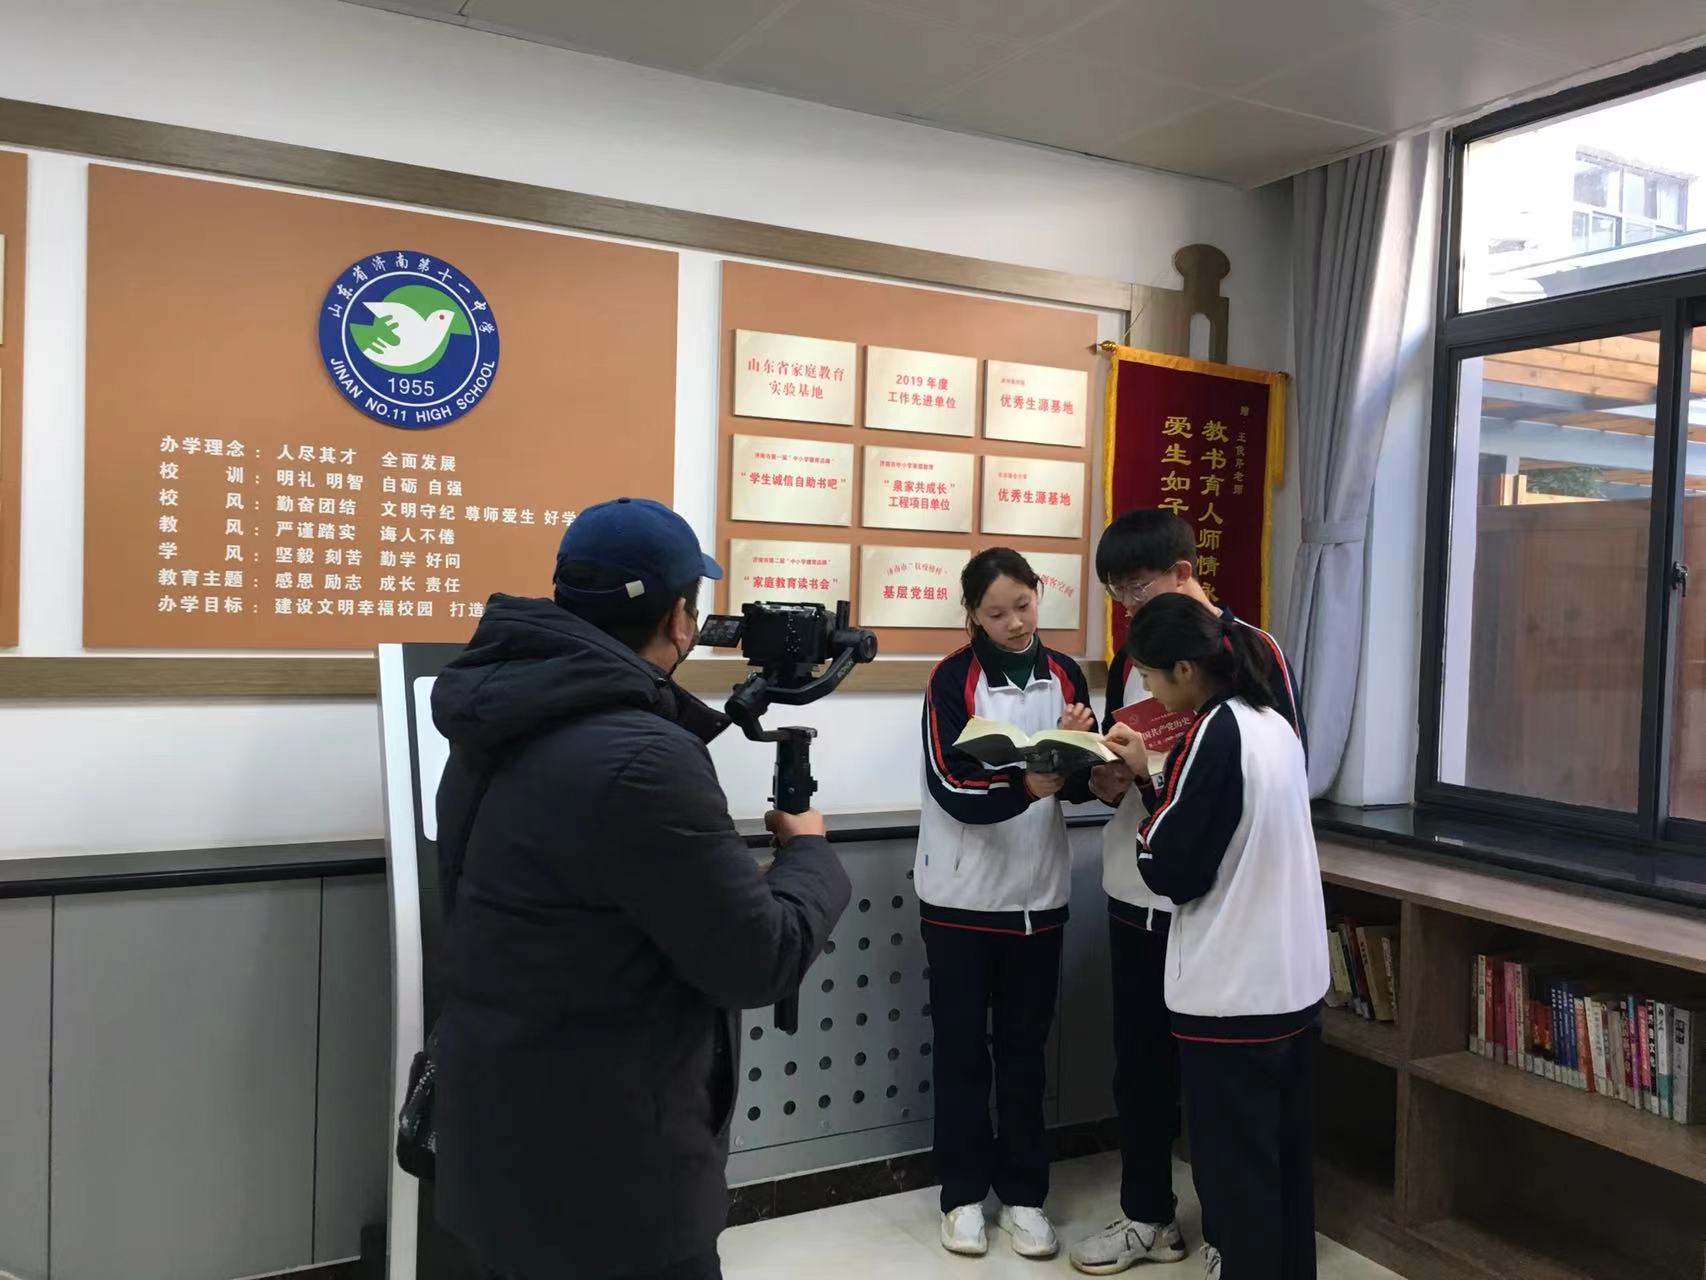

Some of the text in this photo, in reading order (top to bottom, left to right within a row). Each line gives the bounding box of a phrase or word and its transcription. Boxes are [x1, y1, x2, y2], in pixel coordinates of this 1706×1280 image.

[747, 358, 845, 382] 山东省家庭教育
[330, 358, 496, 423] JINAN NO.11 HIGH SCHOOL
[388, 378, 435, 396] 1955
[769, 380, 823, 399] 实验基地
[896, 374, 948, 391] 2019 年度
[888, 391, 956, 409] 工作先进单位
[1000, 394, 1074, 415] 优秀生源基地
[277, 444, 357, 464] 人尽其才
[382, 451, 456, 471] 全面发展
[276, 470, 315, 488] 明礼
[326, 473, 363, 491] 明智
[382, 476, 417, 494] 自砺
[428, 479, 462, 496] 自强
[888, 496, 950, 511] 工程项目单位
[998, 488, 1071, 506] 优秀生源基地
[276, 495, 356, 515] 勤奋团结
[380, 501, 456, 521] 文明守纪
[465, 506, 535, 525] 尊师爱生
[276, 521, 355, 540] 严谨踏实
[380, 526, 455, 545] 诲人不倦
[276, 547, 314, 564] 坚毅
[325, 548, 362, 566] 刻苦
[380, 551, 416, 567] 勤学
[425, 552, 461, 569] 好问
[275, 572, 313, 589] 感恩
[324, 574, 362, 591] 励志
[379, 576, 416, 592] 成长
[425, 577, 461, 593] 责任
[883, 585, 948, 600] 基层党组织
[275, 598, 433, 617] 建设文明幸福校园
